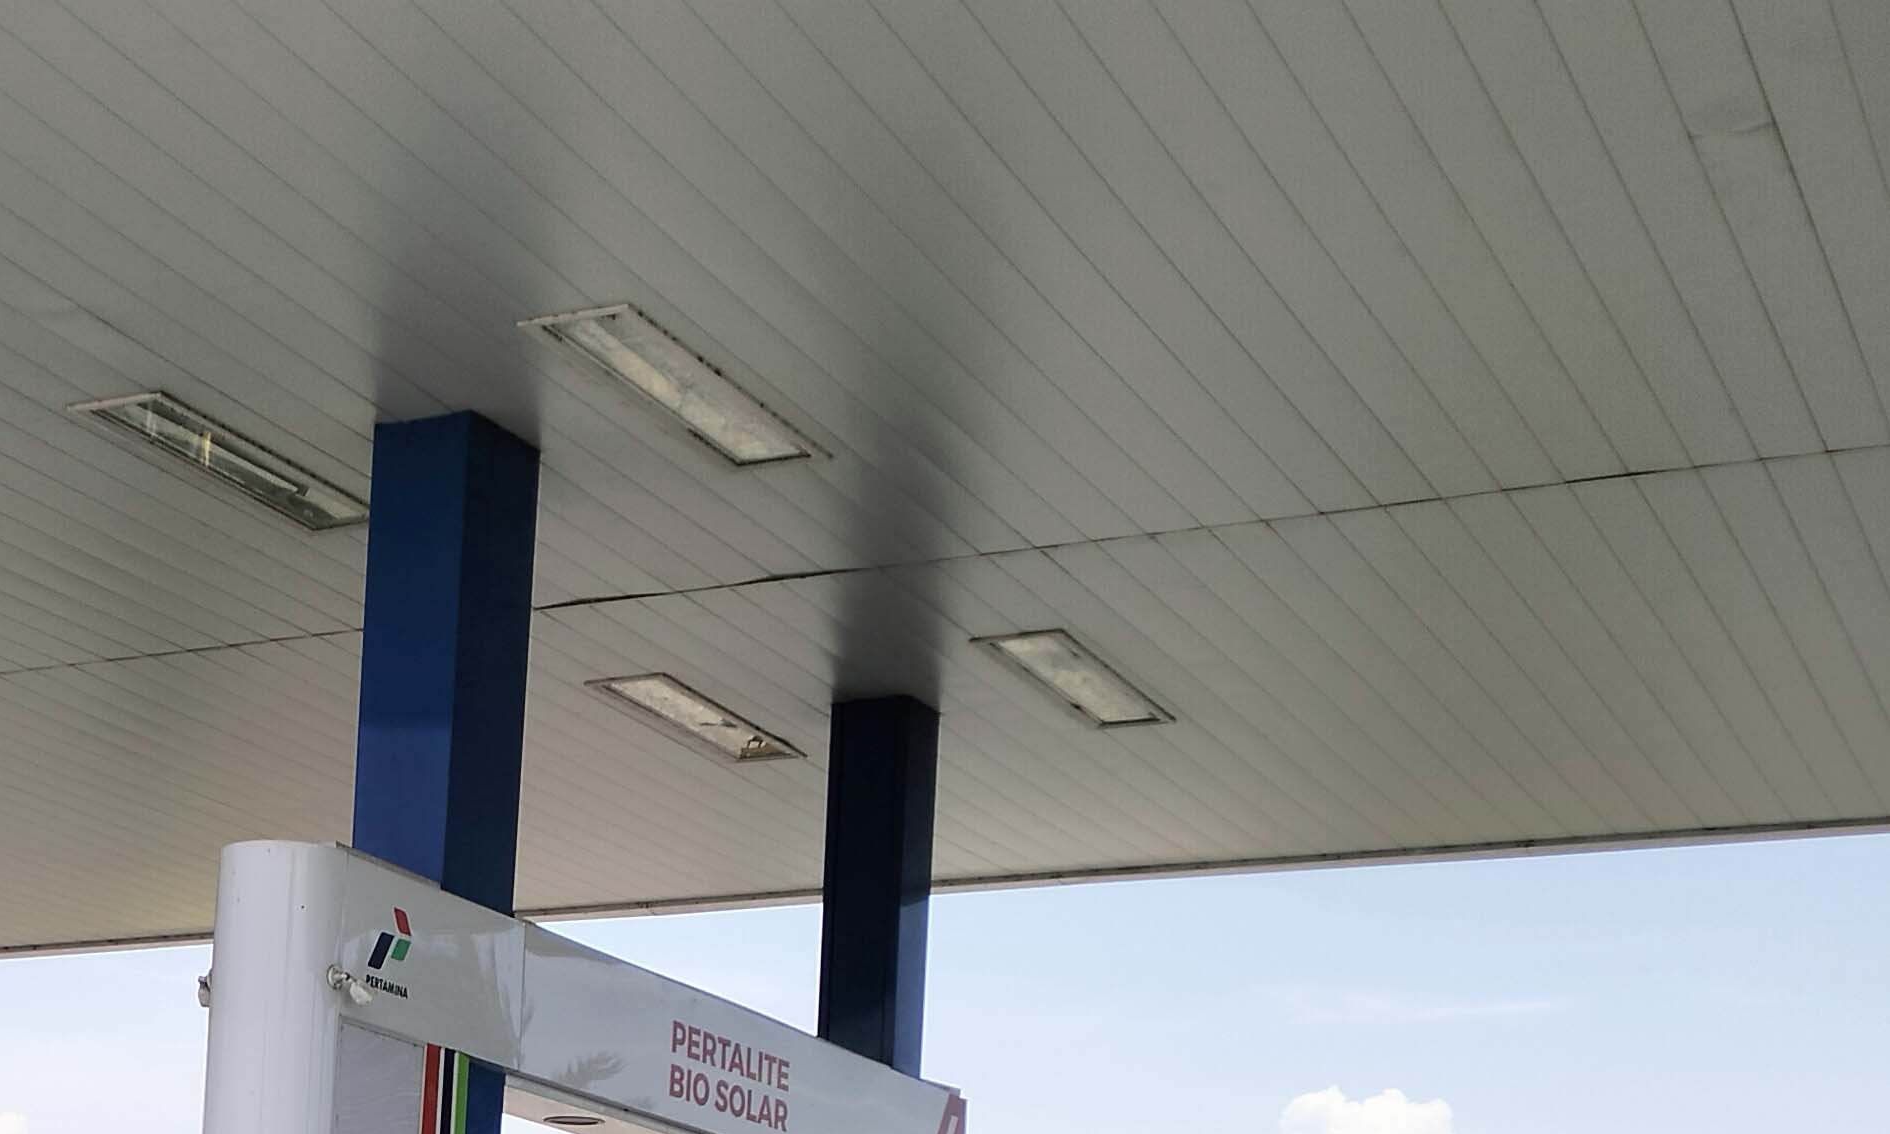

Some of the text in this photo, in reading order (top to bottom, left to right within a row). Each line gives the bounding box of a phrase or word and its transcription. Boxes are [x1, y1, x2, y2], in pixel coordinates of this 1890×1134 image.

[365, 974, 408, 1000] PERTAMINA
[671, 1019, 790, 1092] PERTALITE
[669, 1063, 789, 1132] BIO SOLAR
